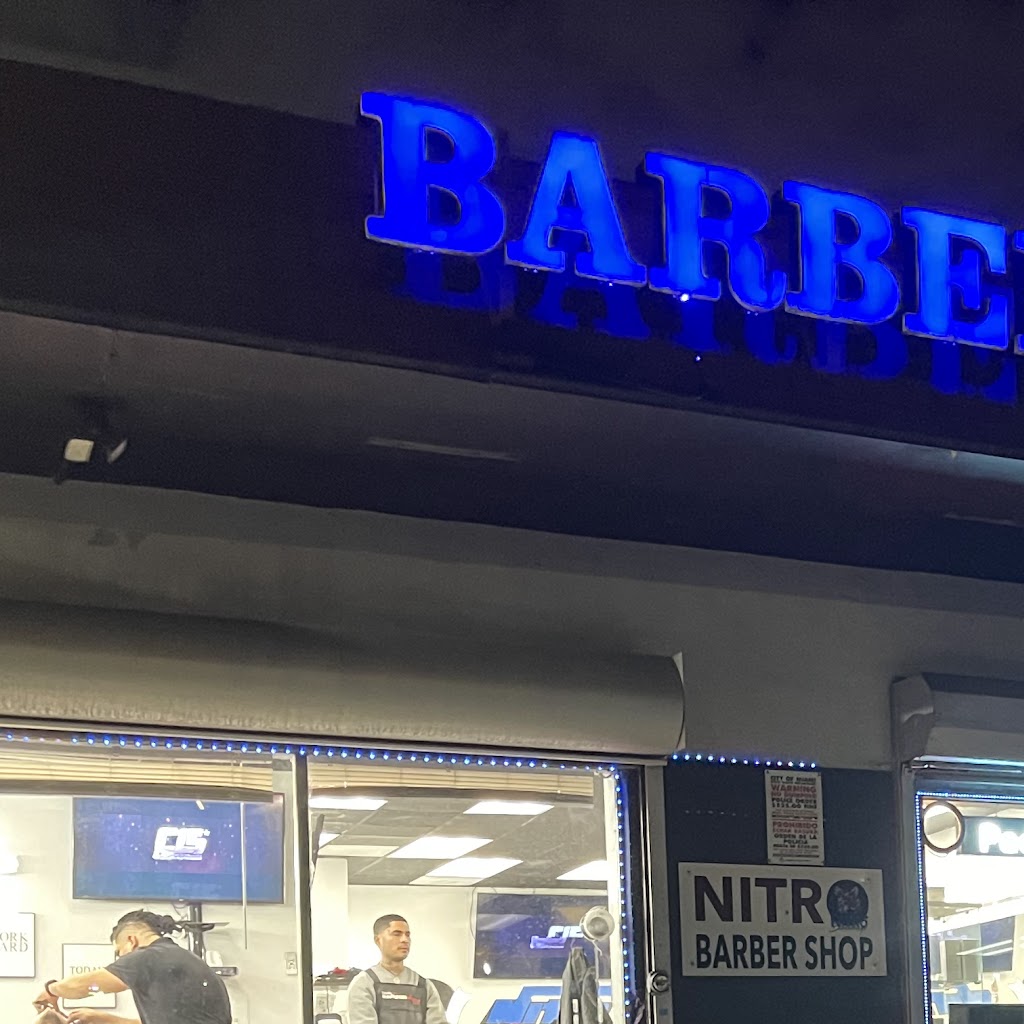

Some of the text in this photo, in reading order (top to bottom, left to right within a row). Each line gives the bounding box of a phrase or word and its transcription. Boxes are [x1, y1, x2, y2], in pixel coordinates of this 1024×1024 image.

[771, 784, 817, 793] WARNING
[696, 933, 873, 970] BARBER SHOP
